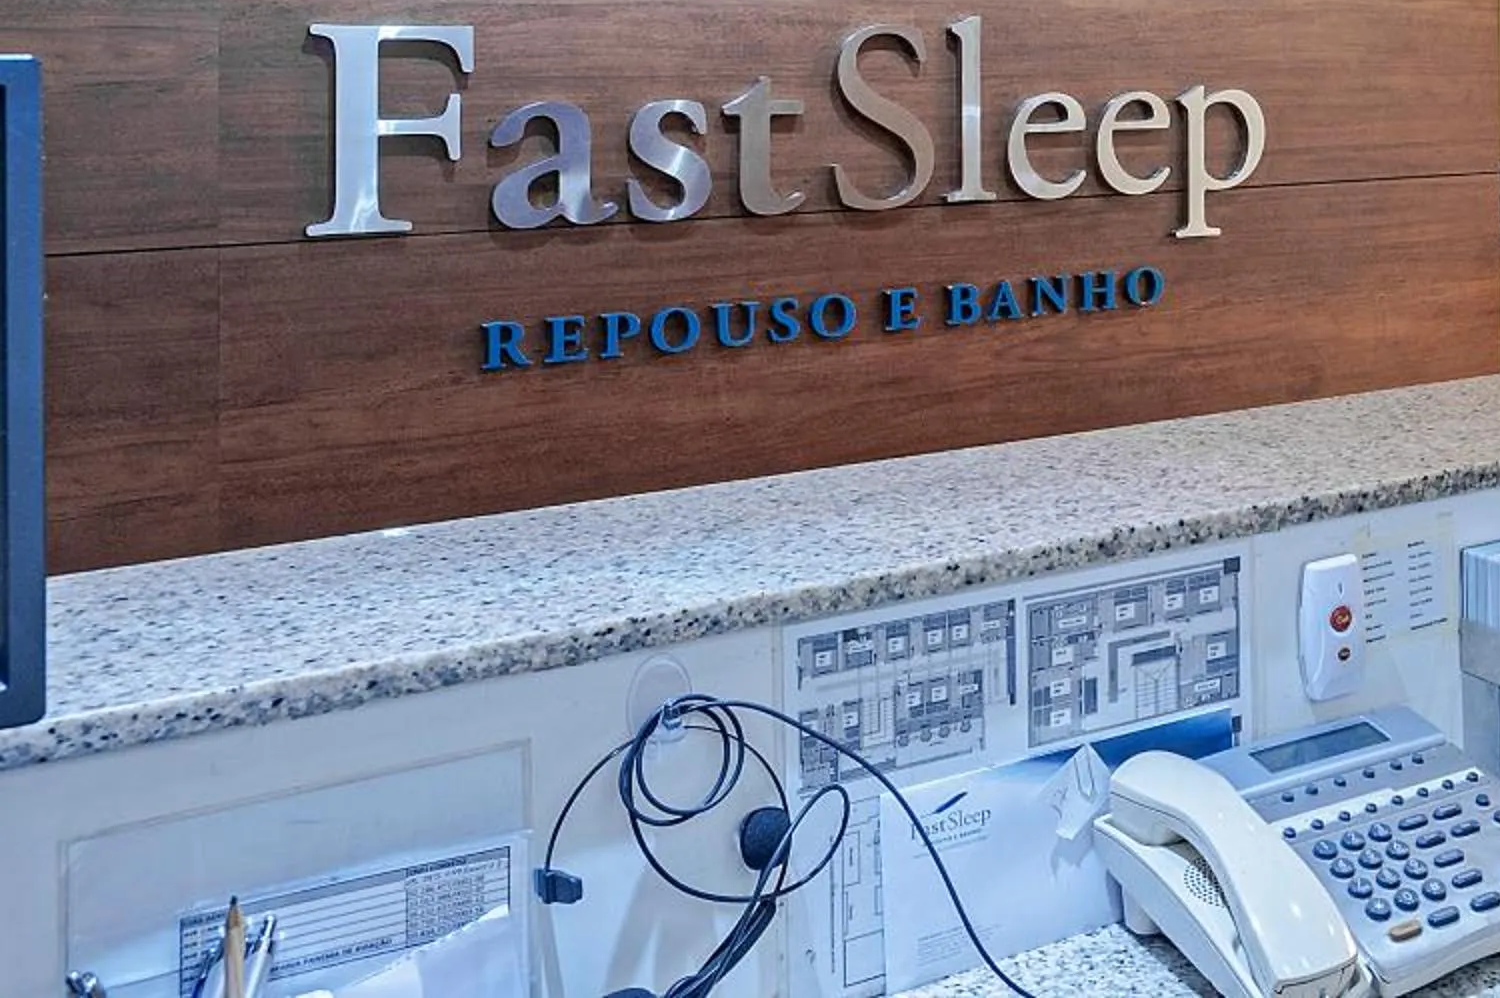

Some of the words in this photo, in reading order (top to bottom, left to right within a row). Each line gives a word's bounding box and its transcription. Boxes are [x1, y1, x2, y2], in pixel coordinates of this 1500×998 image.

[305, 15, 1267, 239] FastSleep
[480, 292, 857, 370] REPOUSO
[882, 288, 923, 331] E
[944, 266, 1166, 327] BANHO
